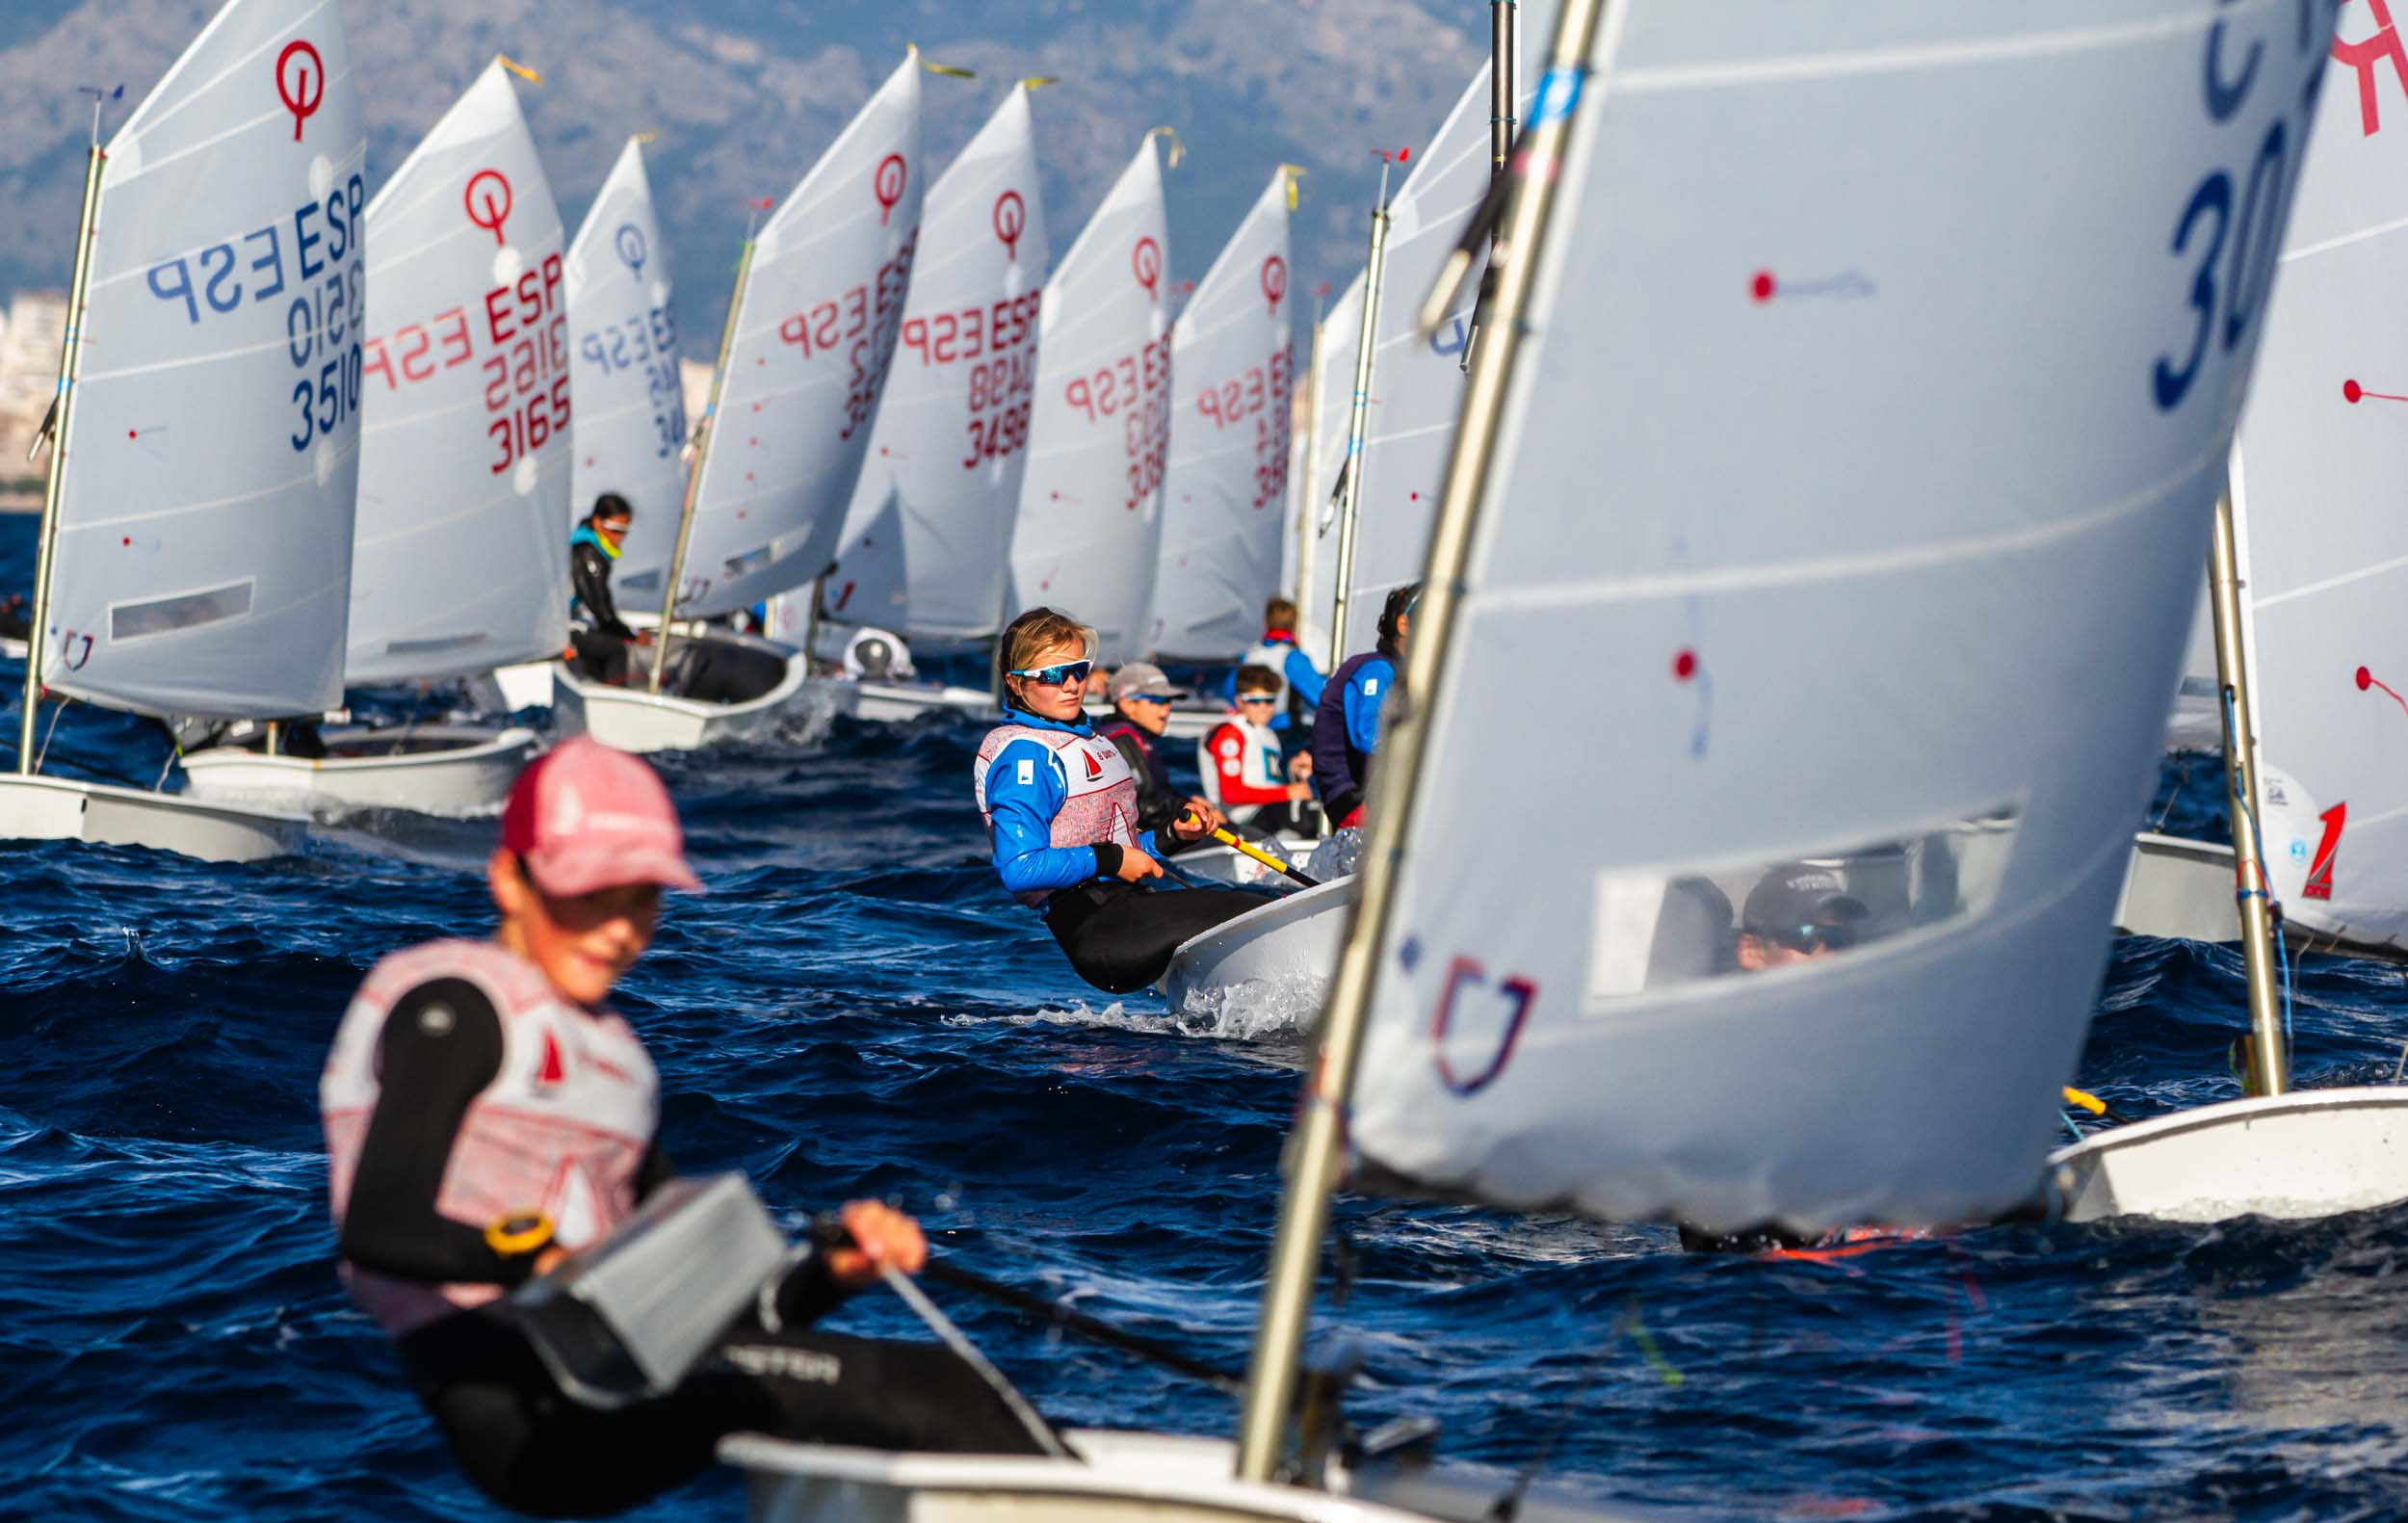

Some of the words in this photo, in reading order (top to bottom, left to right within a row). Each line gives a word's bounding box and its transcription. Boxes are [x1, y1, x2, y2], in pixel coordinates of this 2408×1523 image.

[295, 173, 364, 281] ESP
[485, 251, 563, 346] ESP
[292, 342, 362, 452] 3510
[488, 374, 572, 476] 3165
